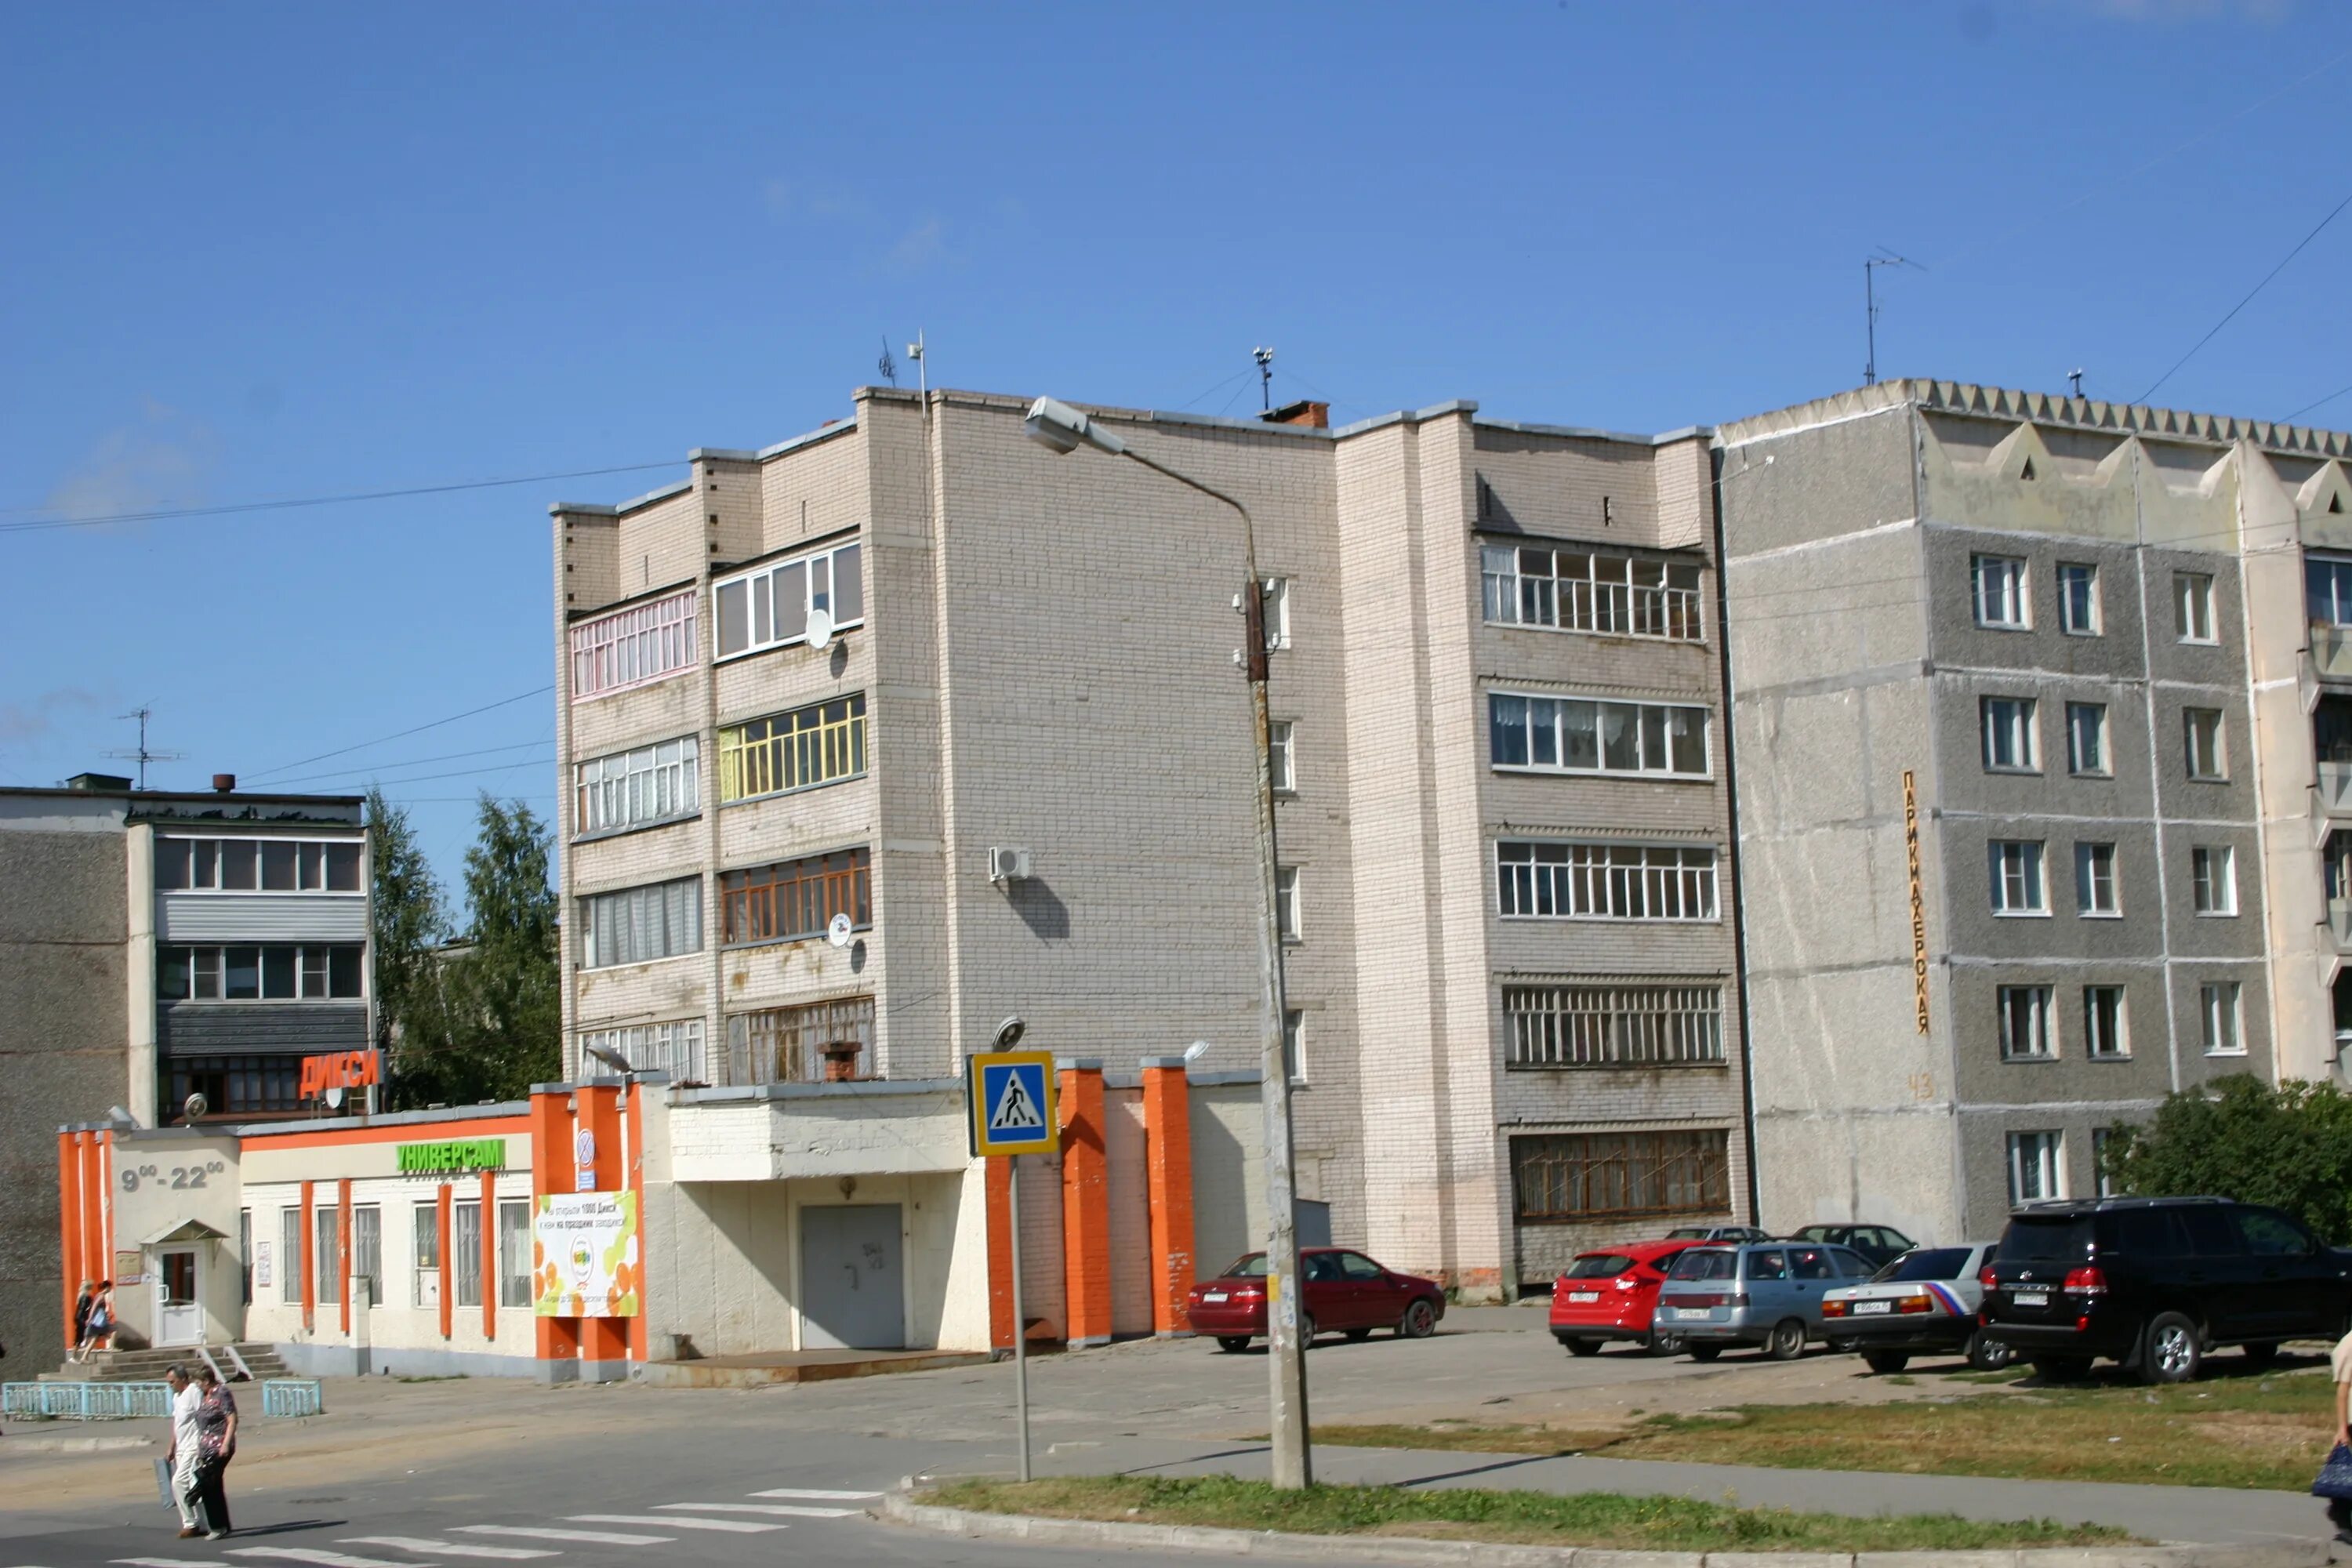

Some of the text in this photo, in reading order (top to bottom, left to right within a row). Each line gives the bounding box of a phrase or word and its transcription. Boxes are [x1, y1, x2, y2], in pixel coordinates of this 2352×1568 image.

[1904, 770, 1929, 1035] ПАРИКМАХЕРСКАЯ
[299, 1049, 379, 1100] ДИКСИ
[397, 1140, 503, 1171] УНИВЕРСАМ
